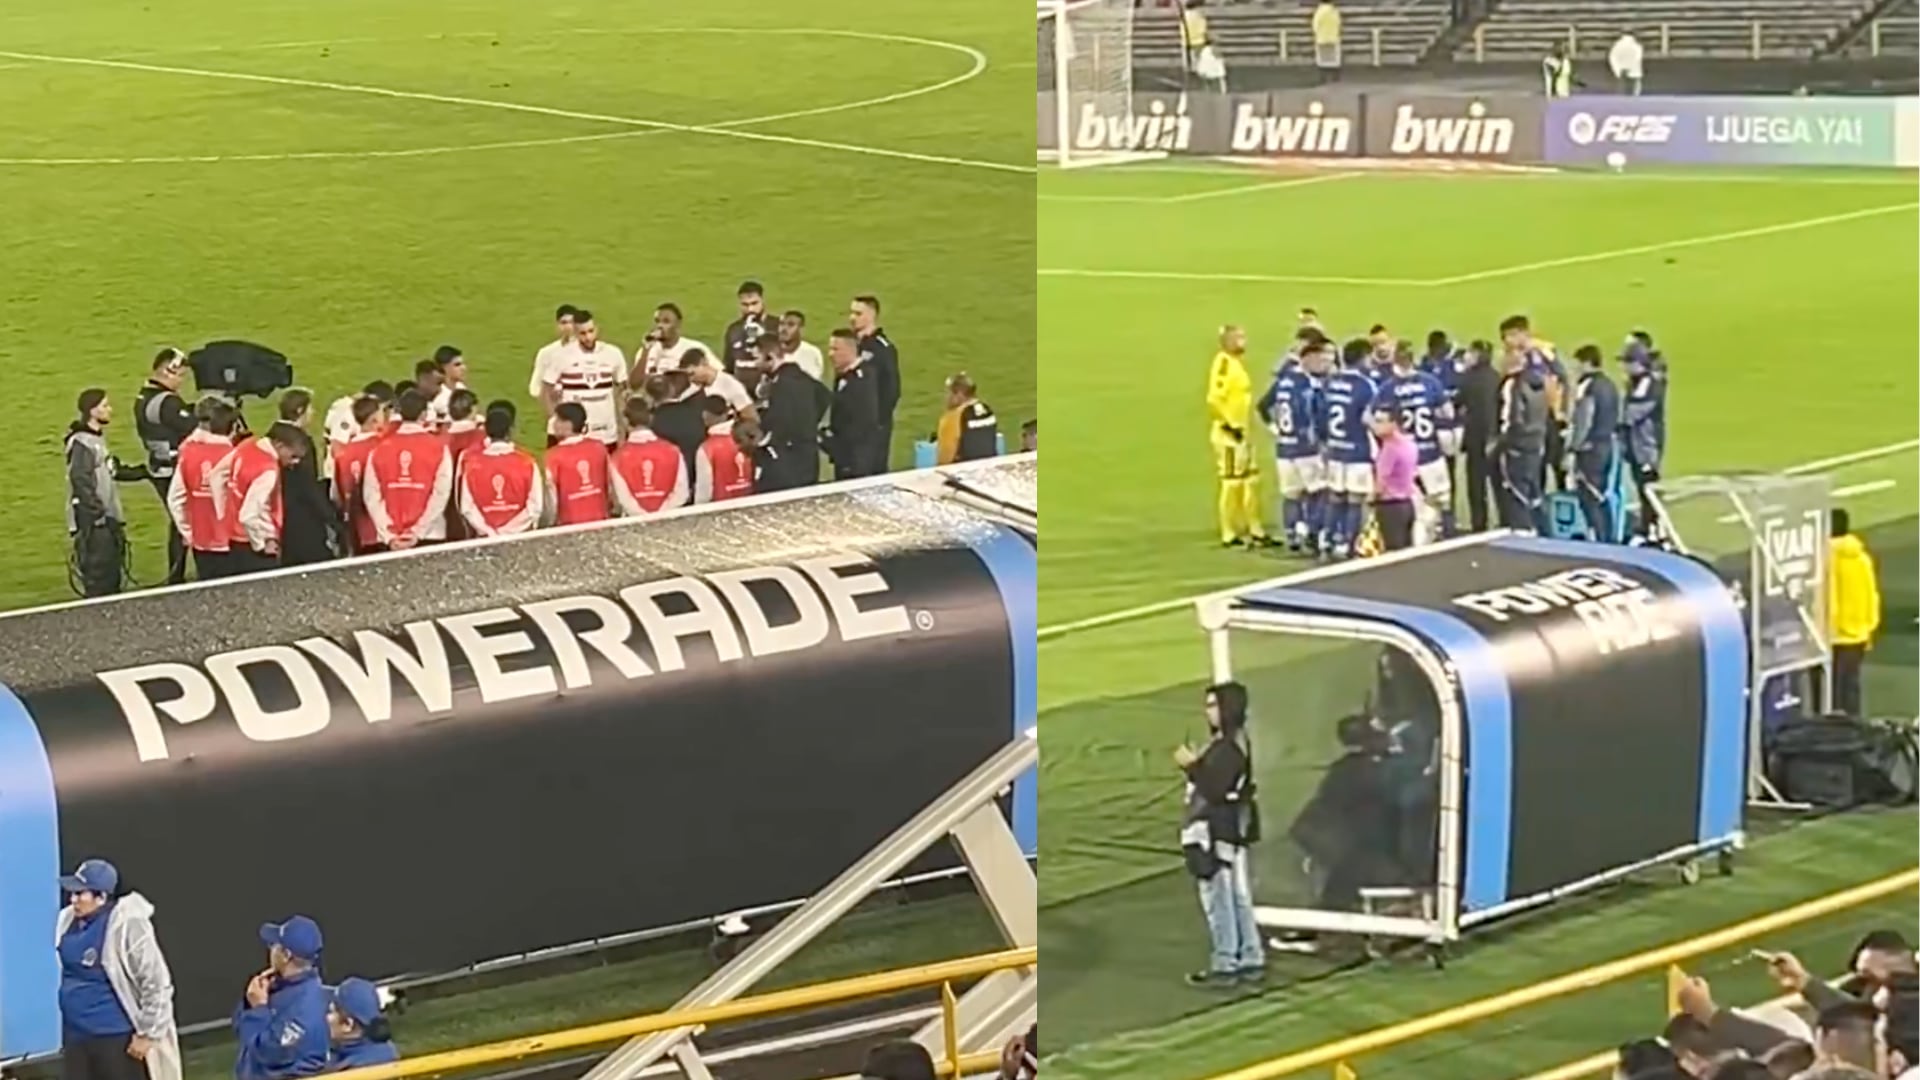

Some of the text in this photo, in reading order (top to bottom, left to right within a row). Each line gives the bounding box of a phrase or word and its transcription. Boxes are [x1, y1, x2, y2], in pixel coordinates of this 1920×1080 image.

[1076, 101, 1191, 148] bwin
[1231, 101, 1351, 151] bwin
[1391, 101, 1514, 153] bwin
[1818, 115, 1864, 145] YA!
[1328, 404, 1347, 438] 2
[96, 552, 912, 762] POWERADE
